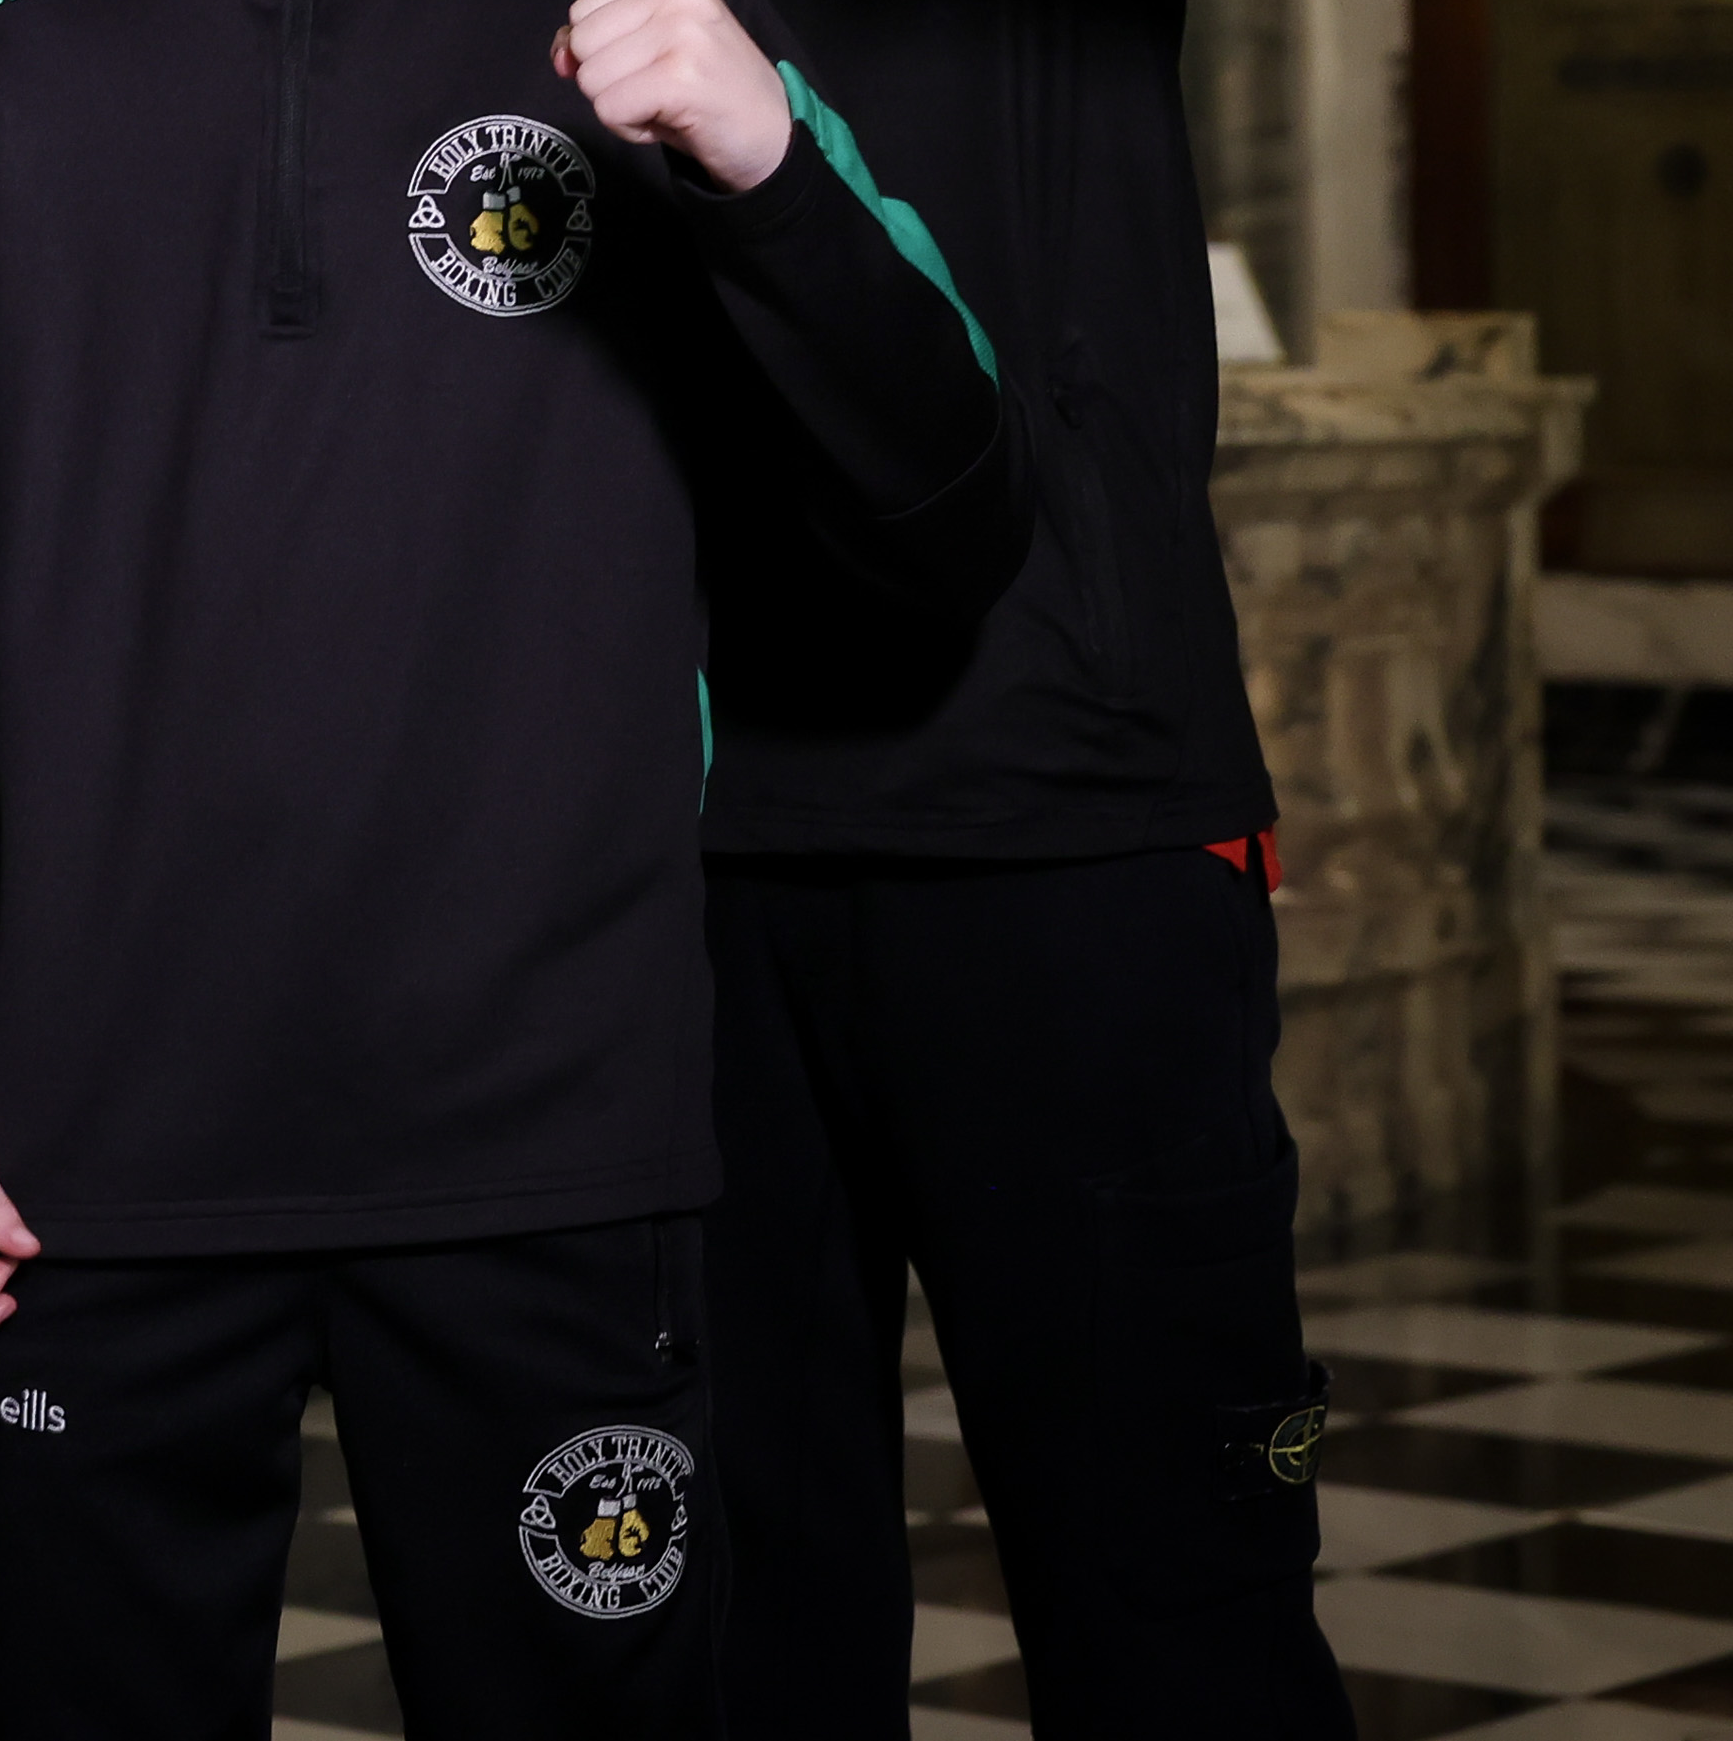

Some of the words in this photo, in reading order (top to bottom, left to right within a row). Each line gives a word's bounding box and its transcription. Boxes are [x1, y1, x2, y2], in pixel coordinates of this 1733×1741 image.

[428, 130, 484, 182] HOLY
[485, 124, 581, 179] TRINITY
[430, 248, 518, 308] BOXING
[534, 247, 581, 300] CLUB
[547, 1438, 606, 1487] HOLY
[612, 1435, 693, 1480] TRINITY
[538, 1551, 621, 1609] BOXING
[639, 1545, 684, 1601] CLUB
